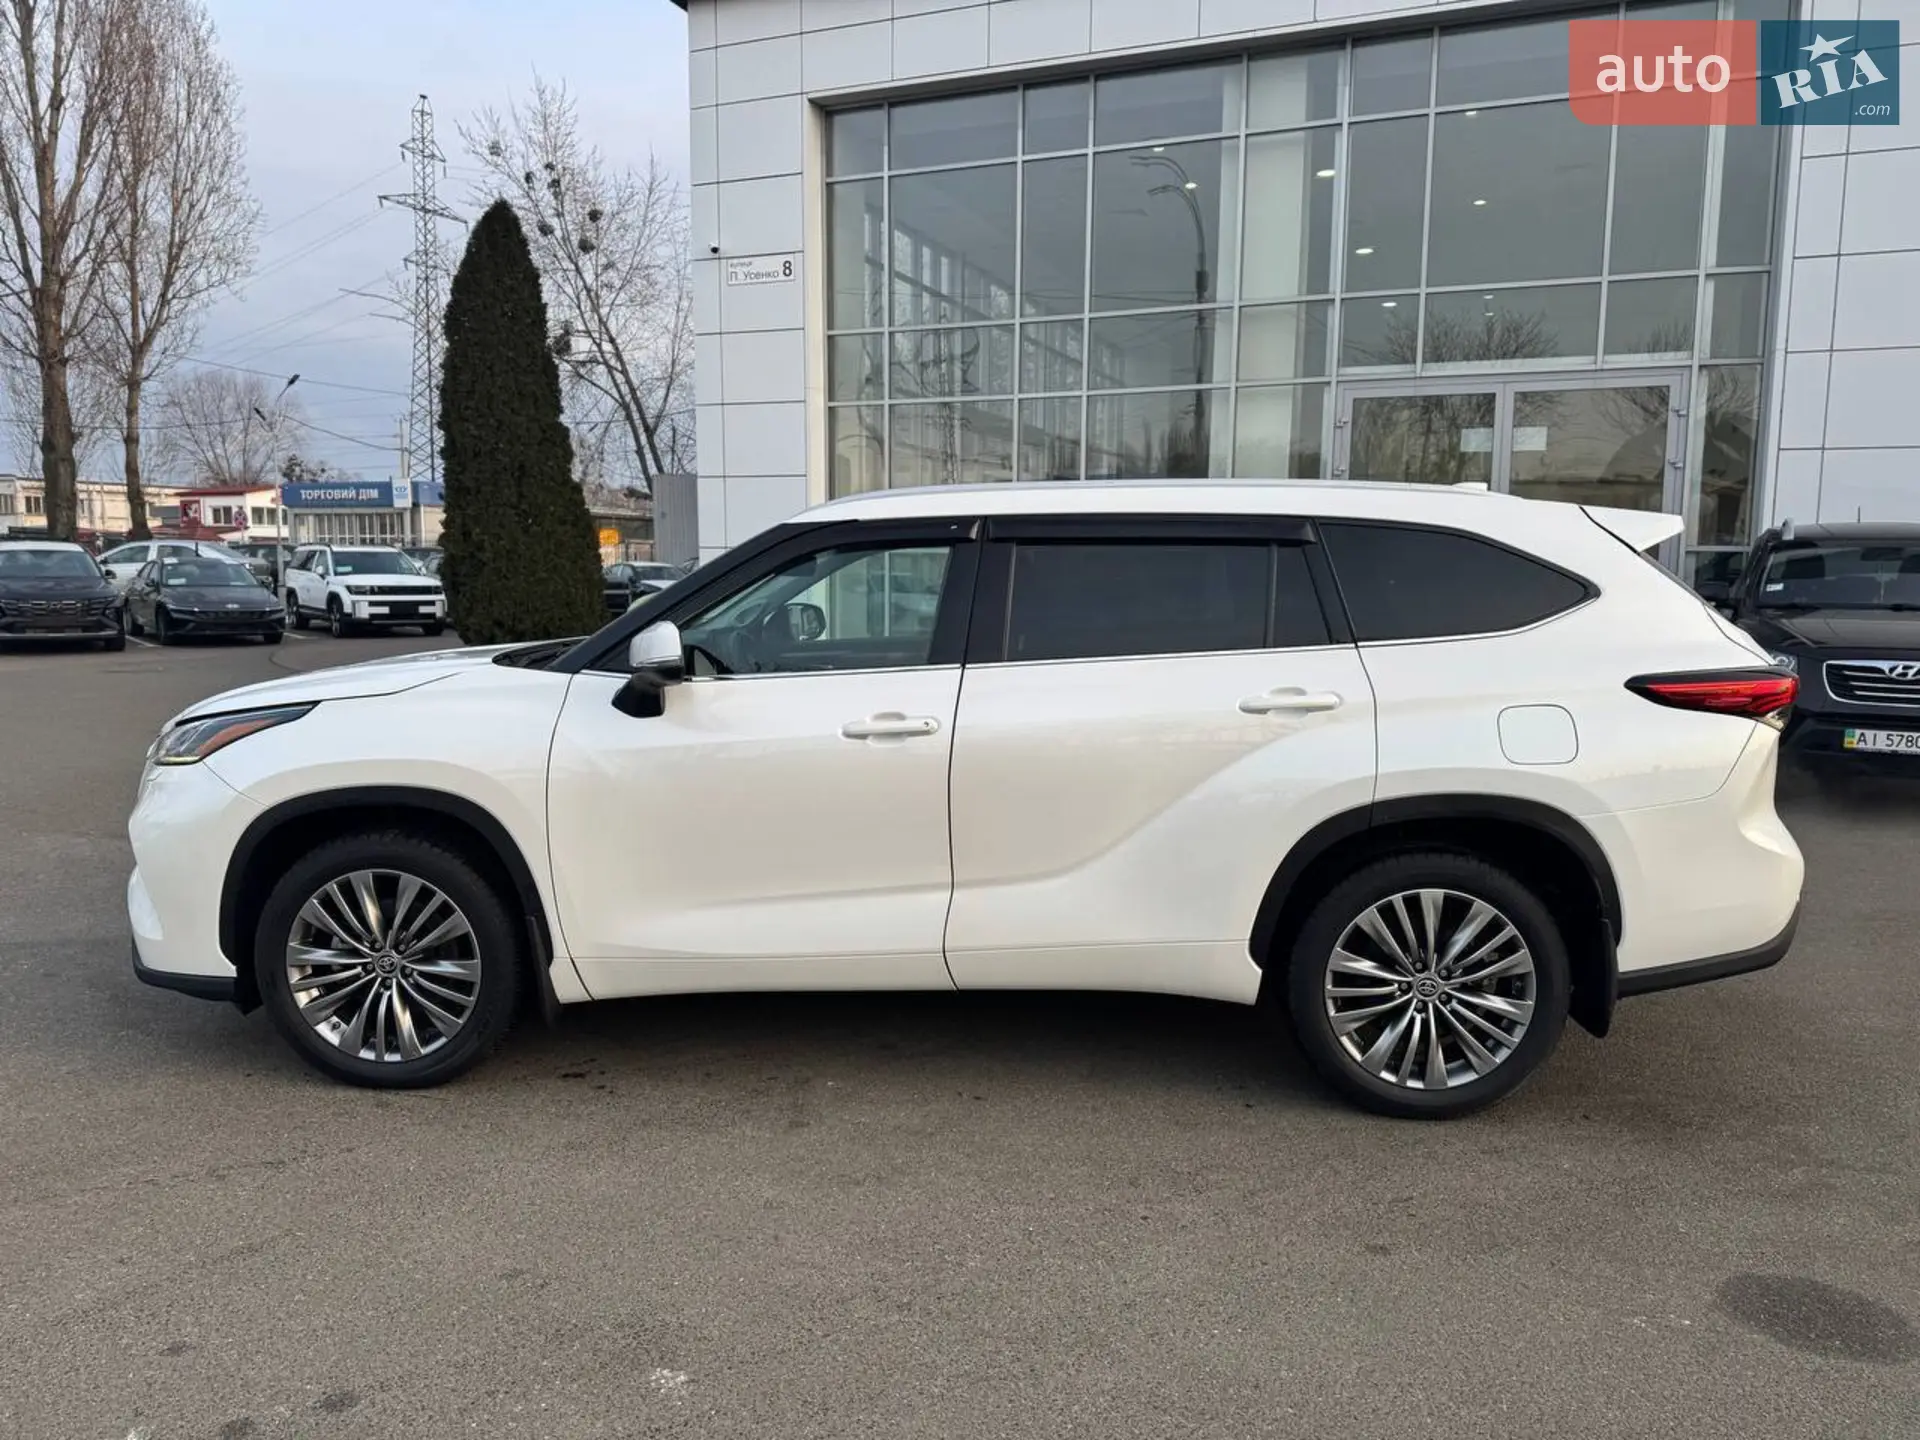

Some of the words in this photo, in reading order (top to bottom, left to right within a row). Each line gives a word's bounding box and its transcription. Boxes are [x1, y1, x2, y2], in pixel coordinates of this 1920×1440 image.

[782, 260, 793, 277] 8
[299, 486, 357, 501] ТОРГОВИЙ
[358, 488, 379, 502] ДІМ
